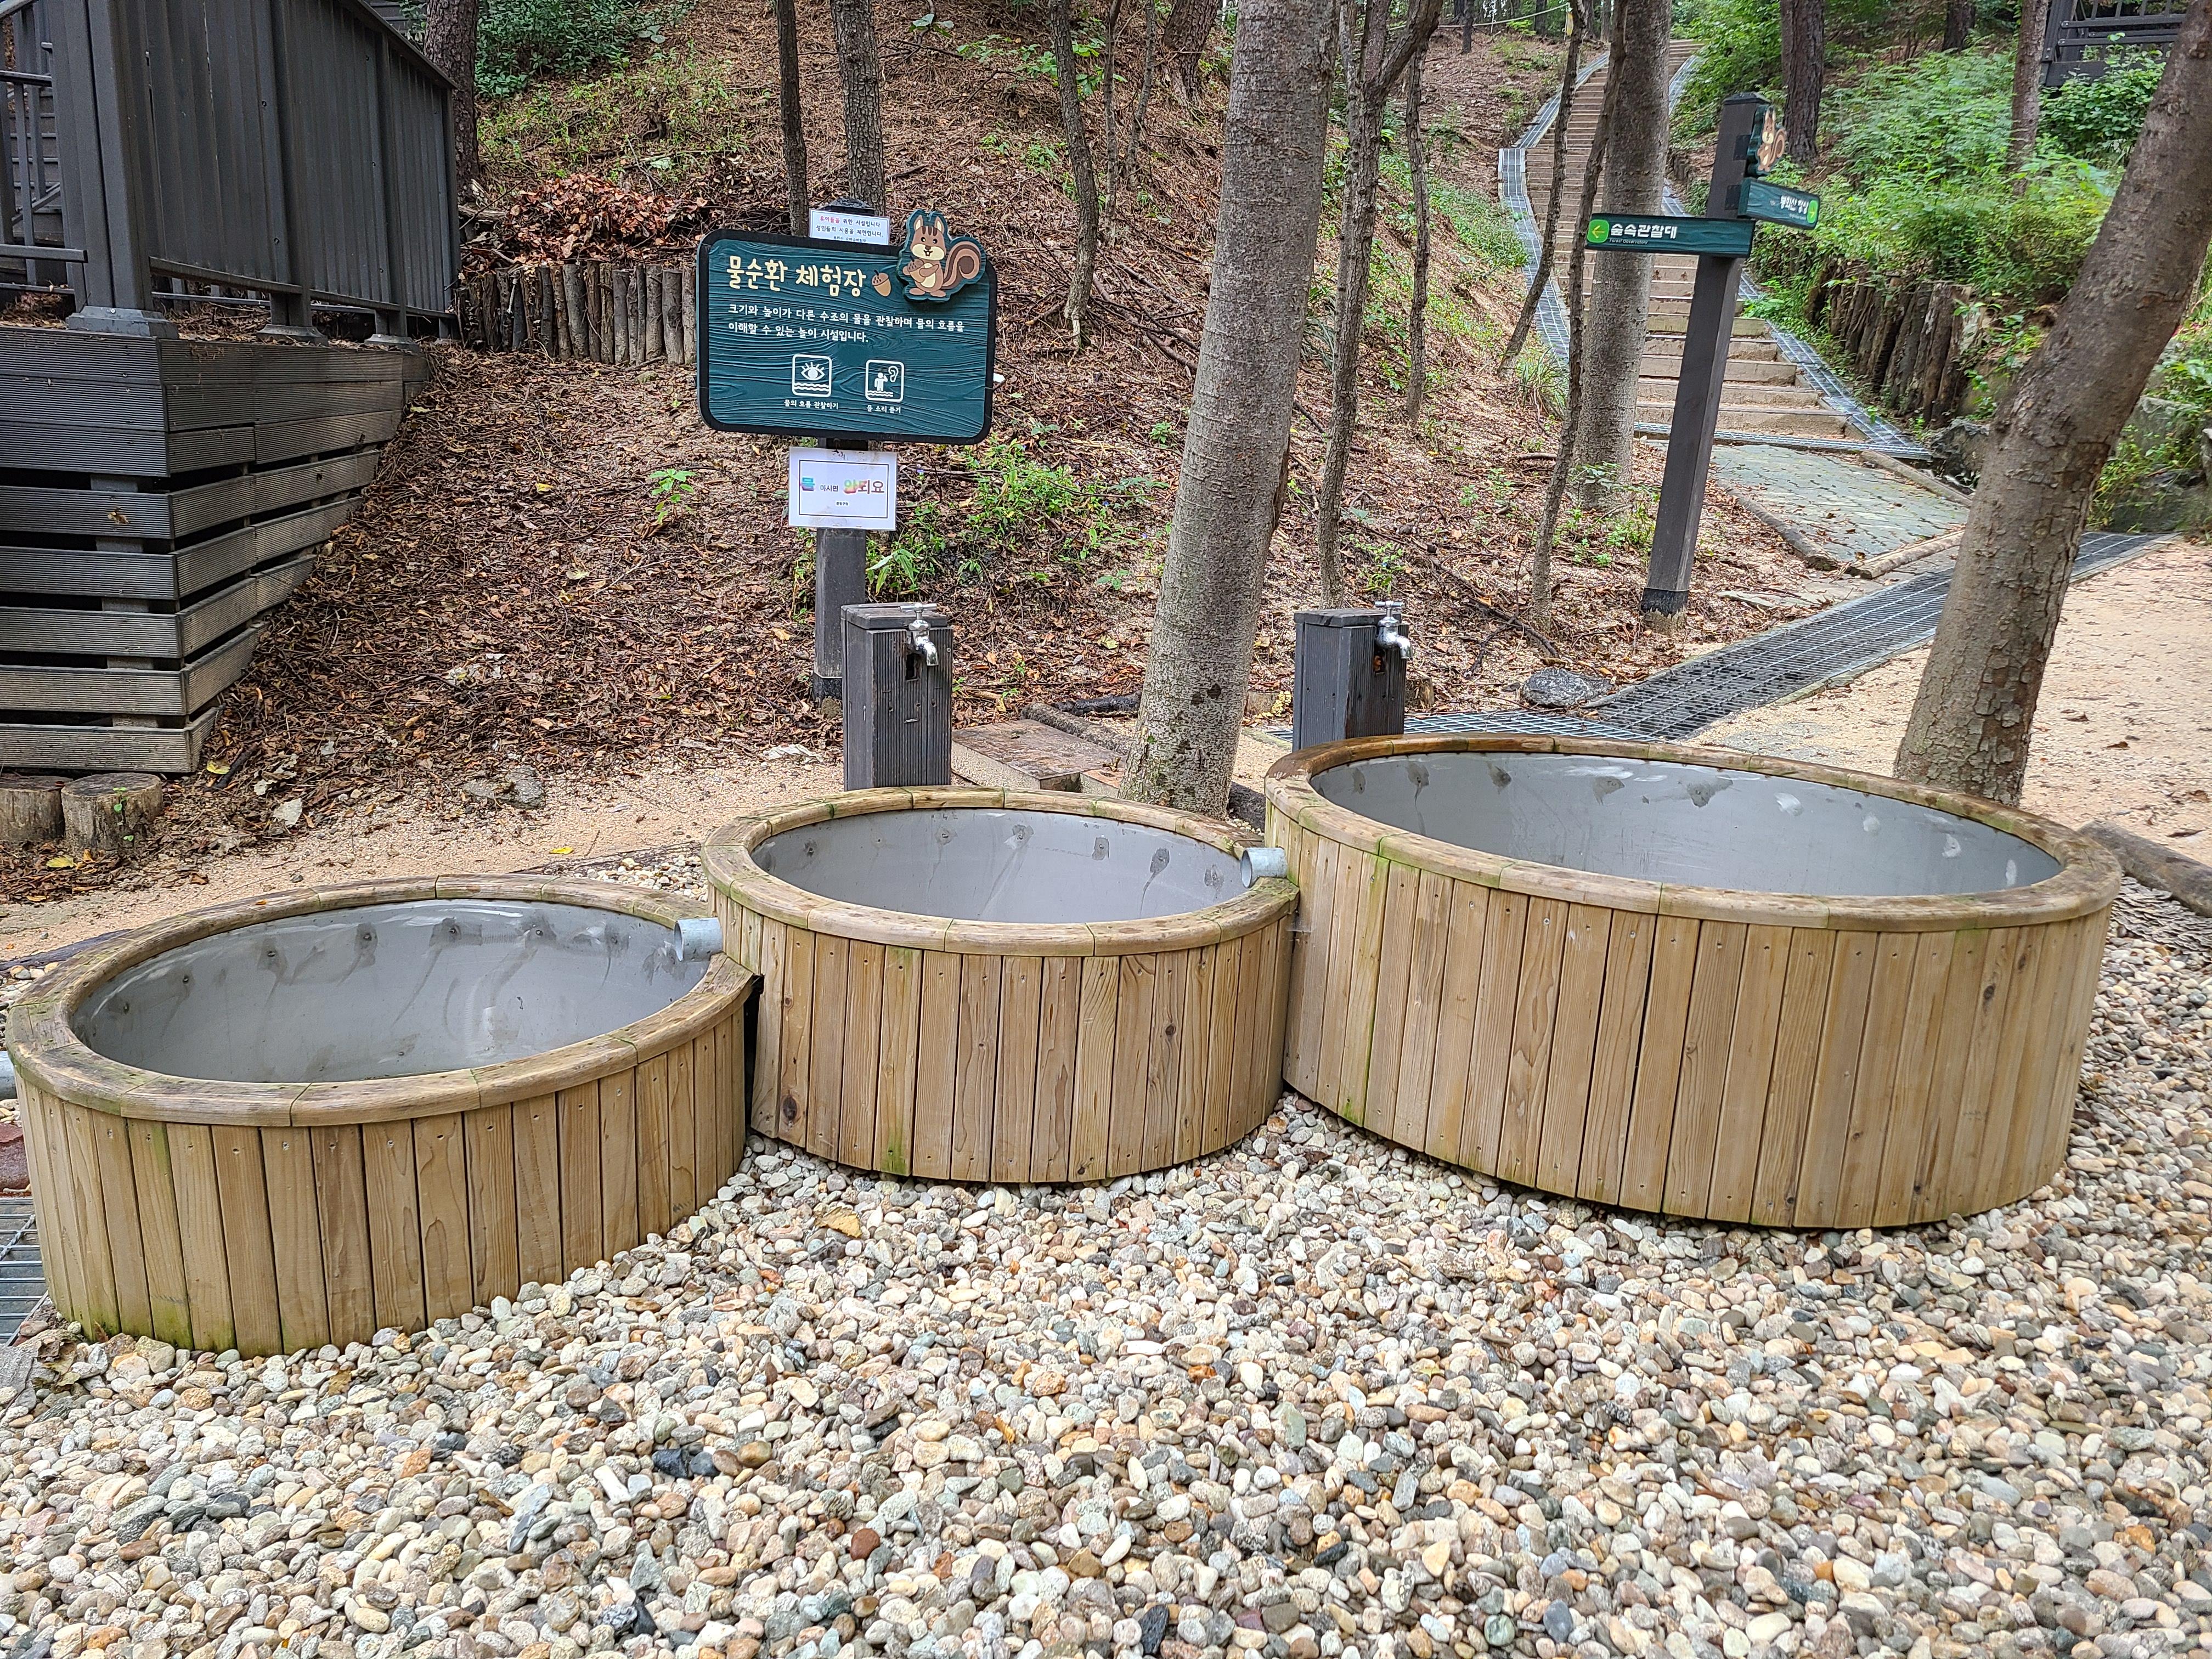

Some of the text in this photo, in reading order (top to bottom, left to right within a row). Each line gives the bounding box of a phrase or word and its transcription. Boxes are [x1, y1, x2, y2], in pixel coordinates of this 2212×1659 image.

[1798, 200, 1809, 214] 정상
[1610, 223, 1678, 239] 숲속관찰대
[726, 256, 867, 297] 물순환 체험장
[728, 304, 965, 332] 크기와 높이가 다른 수조의 물을 관찰하며 물의 흐름을
[728, 321, 868, 343] 이해할 수 있는 놀이 시설입니다.
[813, 401, 838, 410] 관찰하기
[801, 477, 815, 492] 물
[843, 479, 884, 494] 안되요
